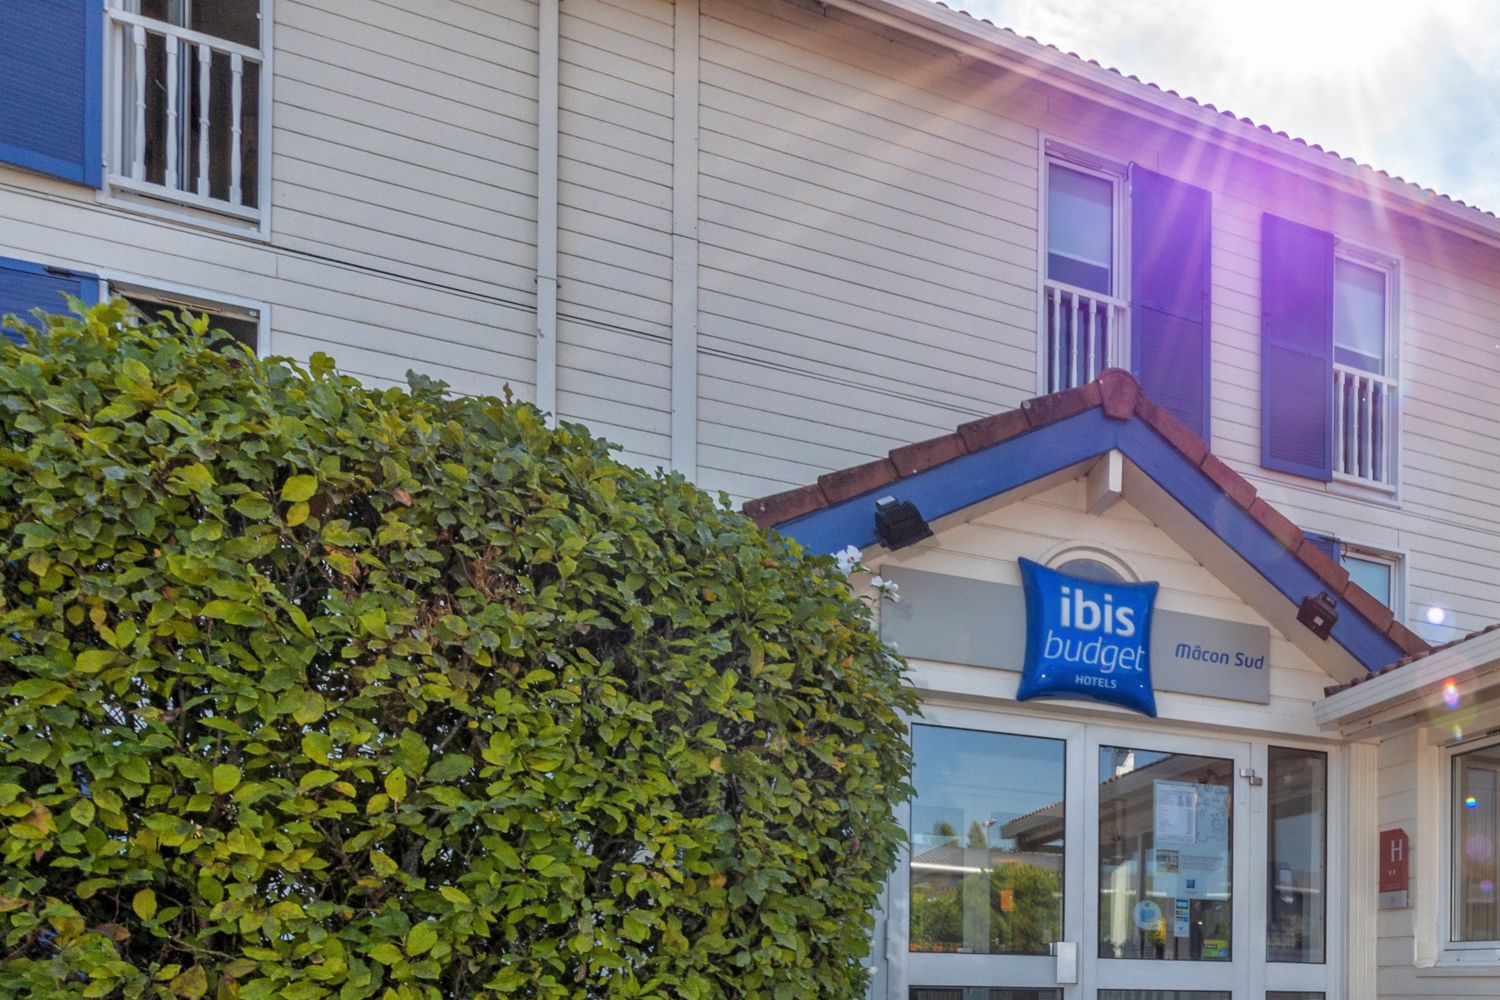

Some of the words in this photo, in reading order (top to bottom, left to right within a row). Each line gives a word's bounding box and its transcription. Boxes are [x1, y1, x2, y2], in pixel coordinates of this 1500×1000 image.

[1061, 586, 1135, 637] ibis
[1044, 629, 1145, 673] budget
[1175, 643, 1230, 665] Mâcon
[1234, 652, 1265, 670] Sud
[1075, 674, 1117, 689] HOTELS
[1390, 838, 1404, 863] H
